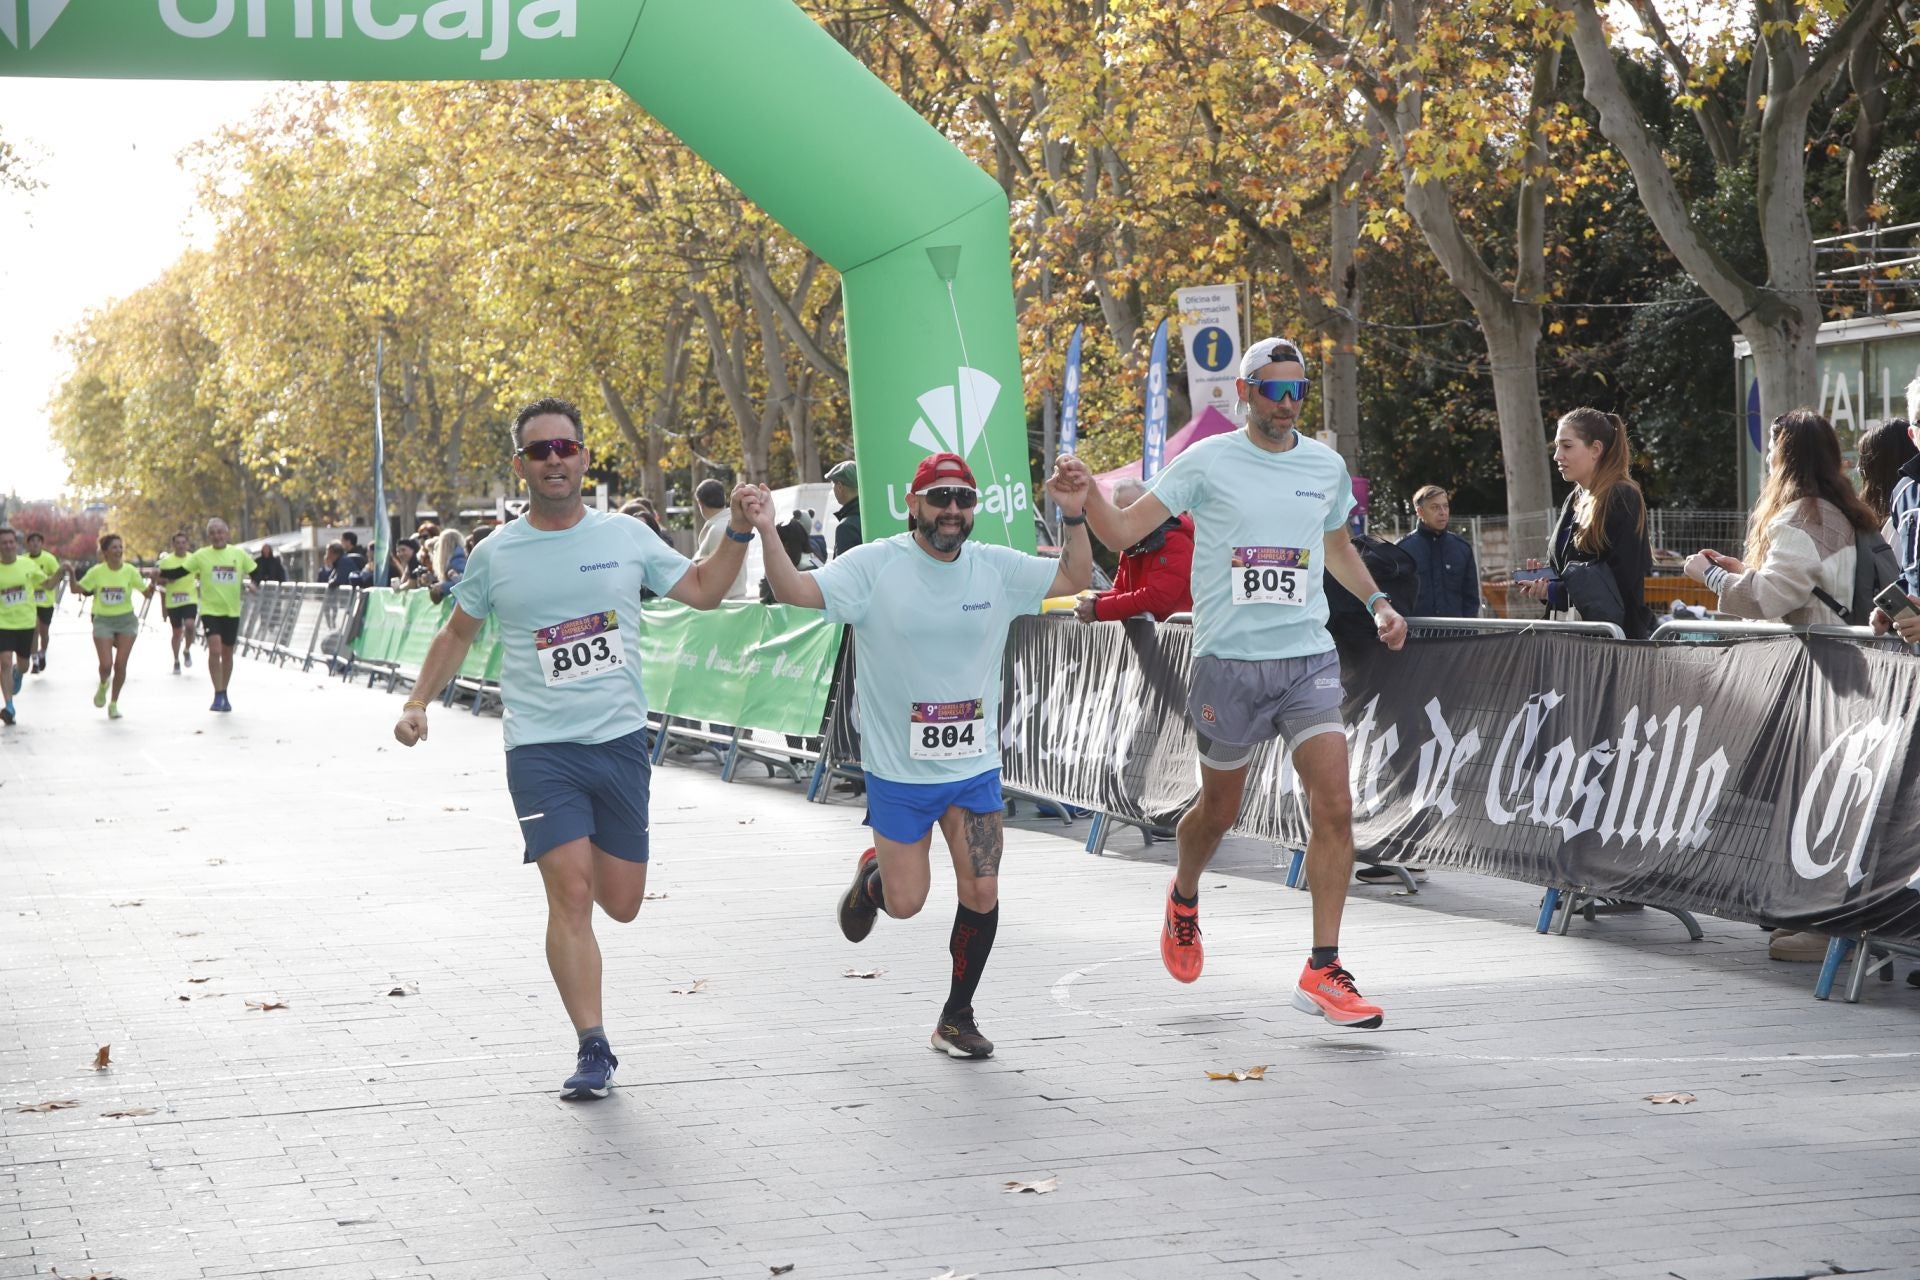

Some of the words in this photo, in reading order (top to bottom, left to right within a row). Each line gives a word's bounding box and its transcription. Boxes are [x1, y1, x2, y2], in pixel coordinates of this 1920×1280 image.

[1185, 295, 1210, 304] Oficina
[1211, 294, 1221, 302] de
[887, 474, 1027, 523] Ucaja
[580, 560, 620, 573] OneHealth
[1243, 569, 1296, 593] 805
[962, 601, 992, 612] OneHealth
[561, 623, 592, 636] EMPRESAS
[552, 636, 611, 672] 803
[921, 722, 975, 748] 804
[1409, 696, 1481, 820] de
[1485, 688, 1730, 853] Castilla
